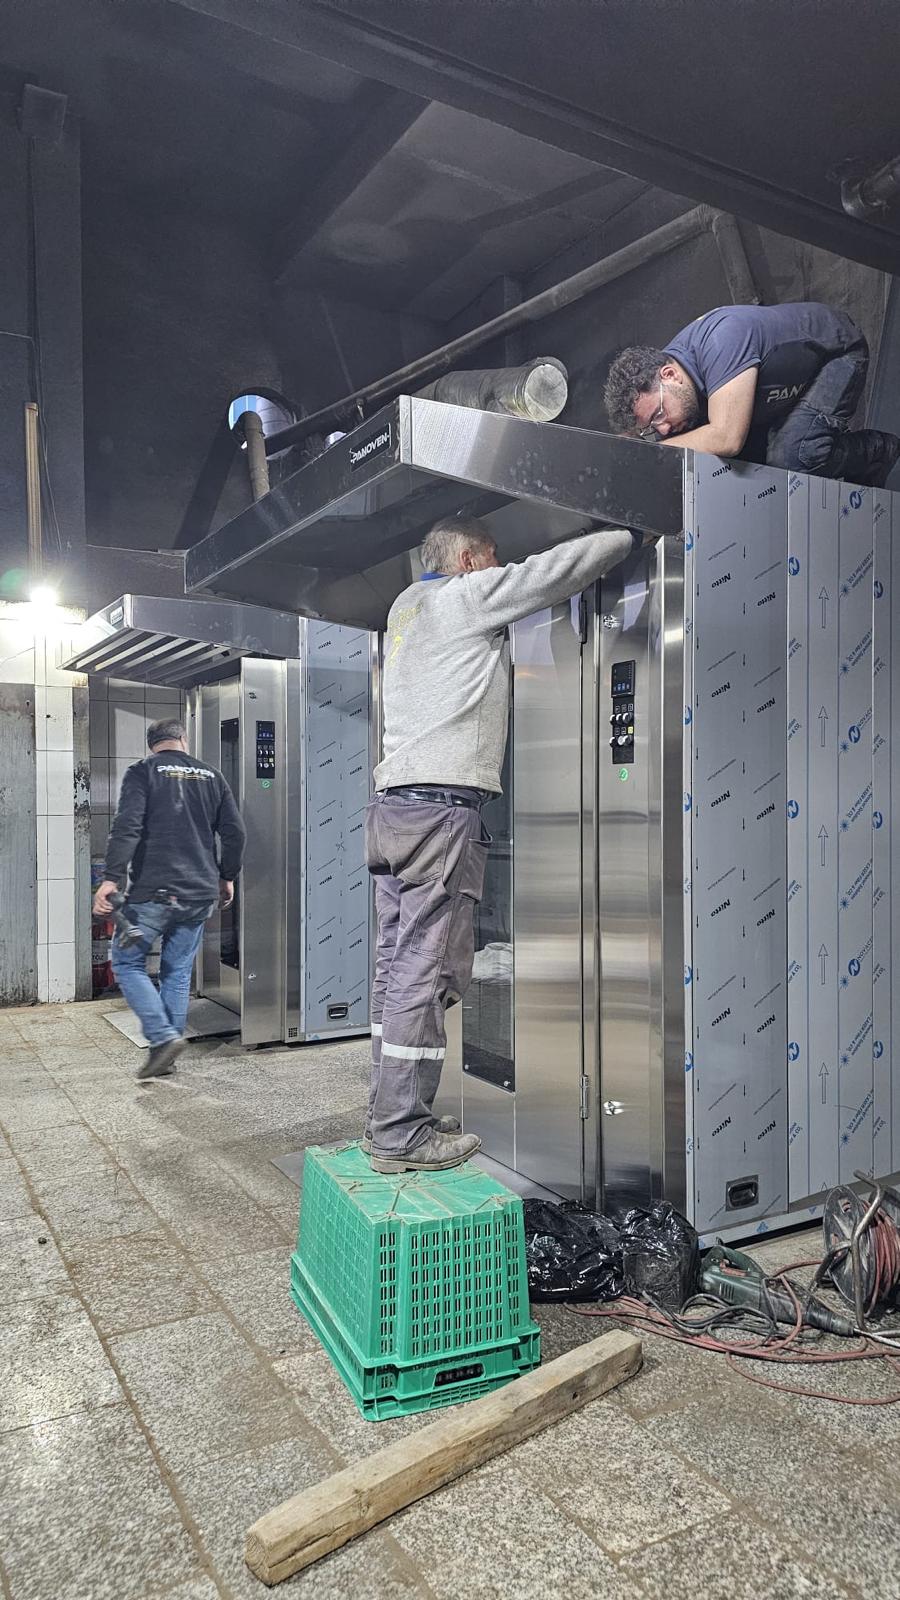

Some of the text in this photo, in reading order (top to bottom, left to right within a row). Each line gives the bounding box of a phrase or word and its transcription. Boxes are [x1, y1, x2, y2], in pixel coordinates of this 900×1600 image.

[766, 383, 805, 403] PAN
[350, 432, 388, 464] PANOVEN
[712, 463, 732, 478] Nitto
[758, 485, 776, 498] Nitto
[712, 573, 731, 588] Nitto
[758, 592, 775, 606] Nitto
[712, 682, 730, 697] Nitto
[757, 698, 775, 712] Nitto
[711, 790, 730, 807] Nitto
[757, 803, 775, 820] Nitto
[711, 899, 730, 917] Nitto
[757, 909, 775, 926] Nitto
[712, 1008, 730, 1026] Nitto
[757, 1014, 775, 1032] Nitto
[712, 1117, 731, 1136] Nitto
[758, 1121, 776, 1140] Nitto
